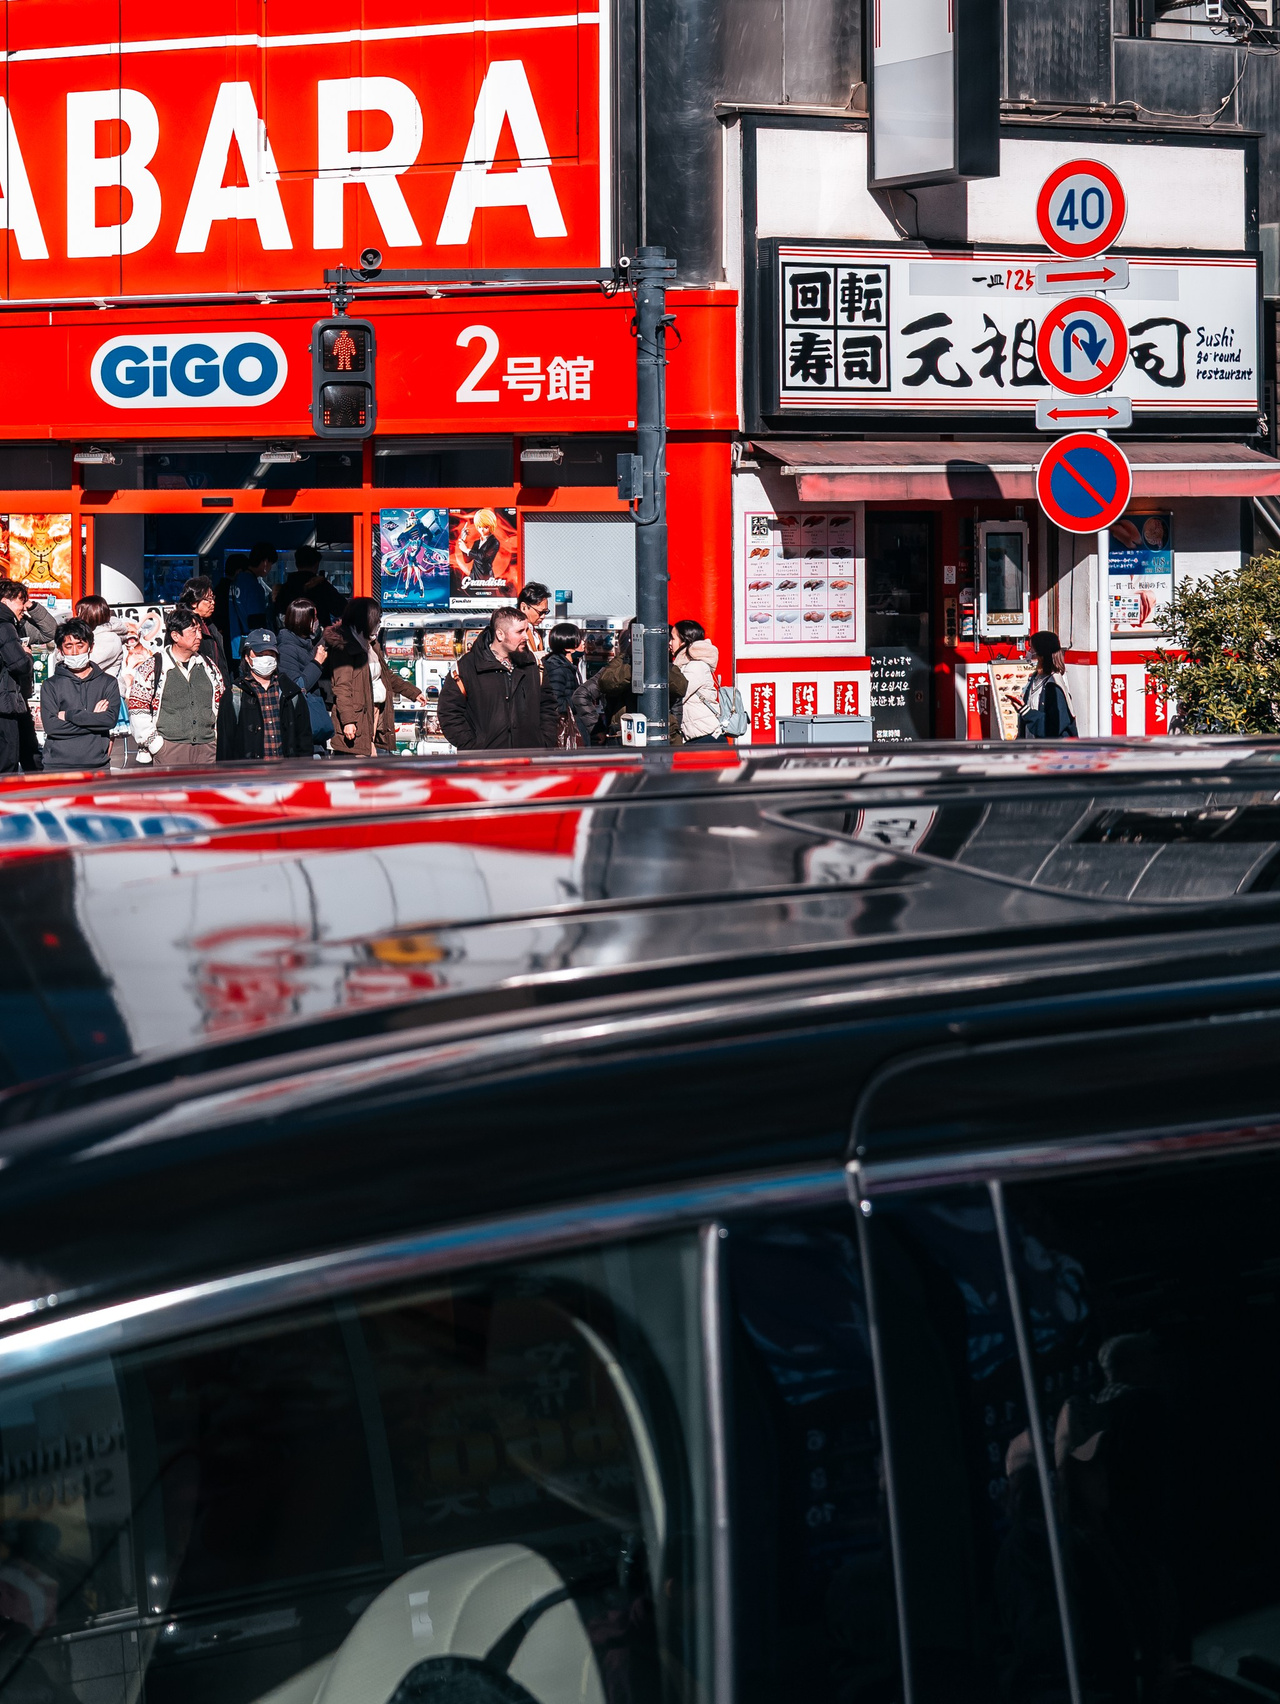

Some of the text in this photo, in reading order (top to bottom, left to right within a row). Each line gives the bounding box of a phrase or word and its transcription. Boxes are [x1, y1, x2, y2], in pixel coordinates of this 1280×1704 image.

[1057, 187, 1105, 231] 40
[789, 271, 883, 323] 回転
[789, 331, 883, 385] 寿司
[901, 312, 1192, 388] 元祖司
[1196, 326, 1234, 347] Sushi
[1197, 349, 1242, 365] go-round
[101, 342, 278, 398] GiGO
[454, 324, 594, 404] 2号館
[1196, 367, 1253, 381] restaurant
[461, 576, 506, 590] Grandista
